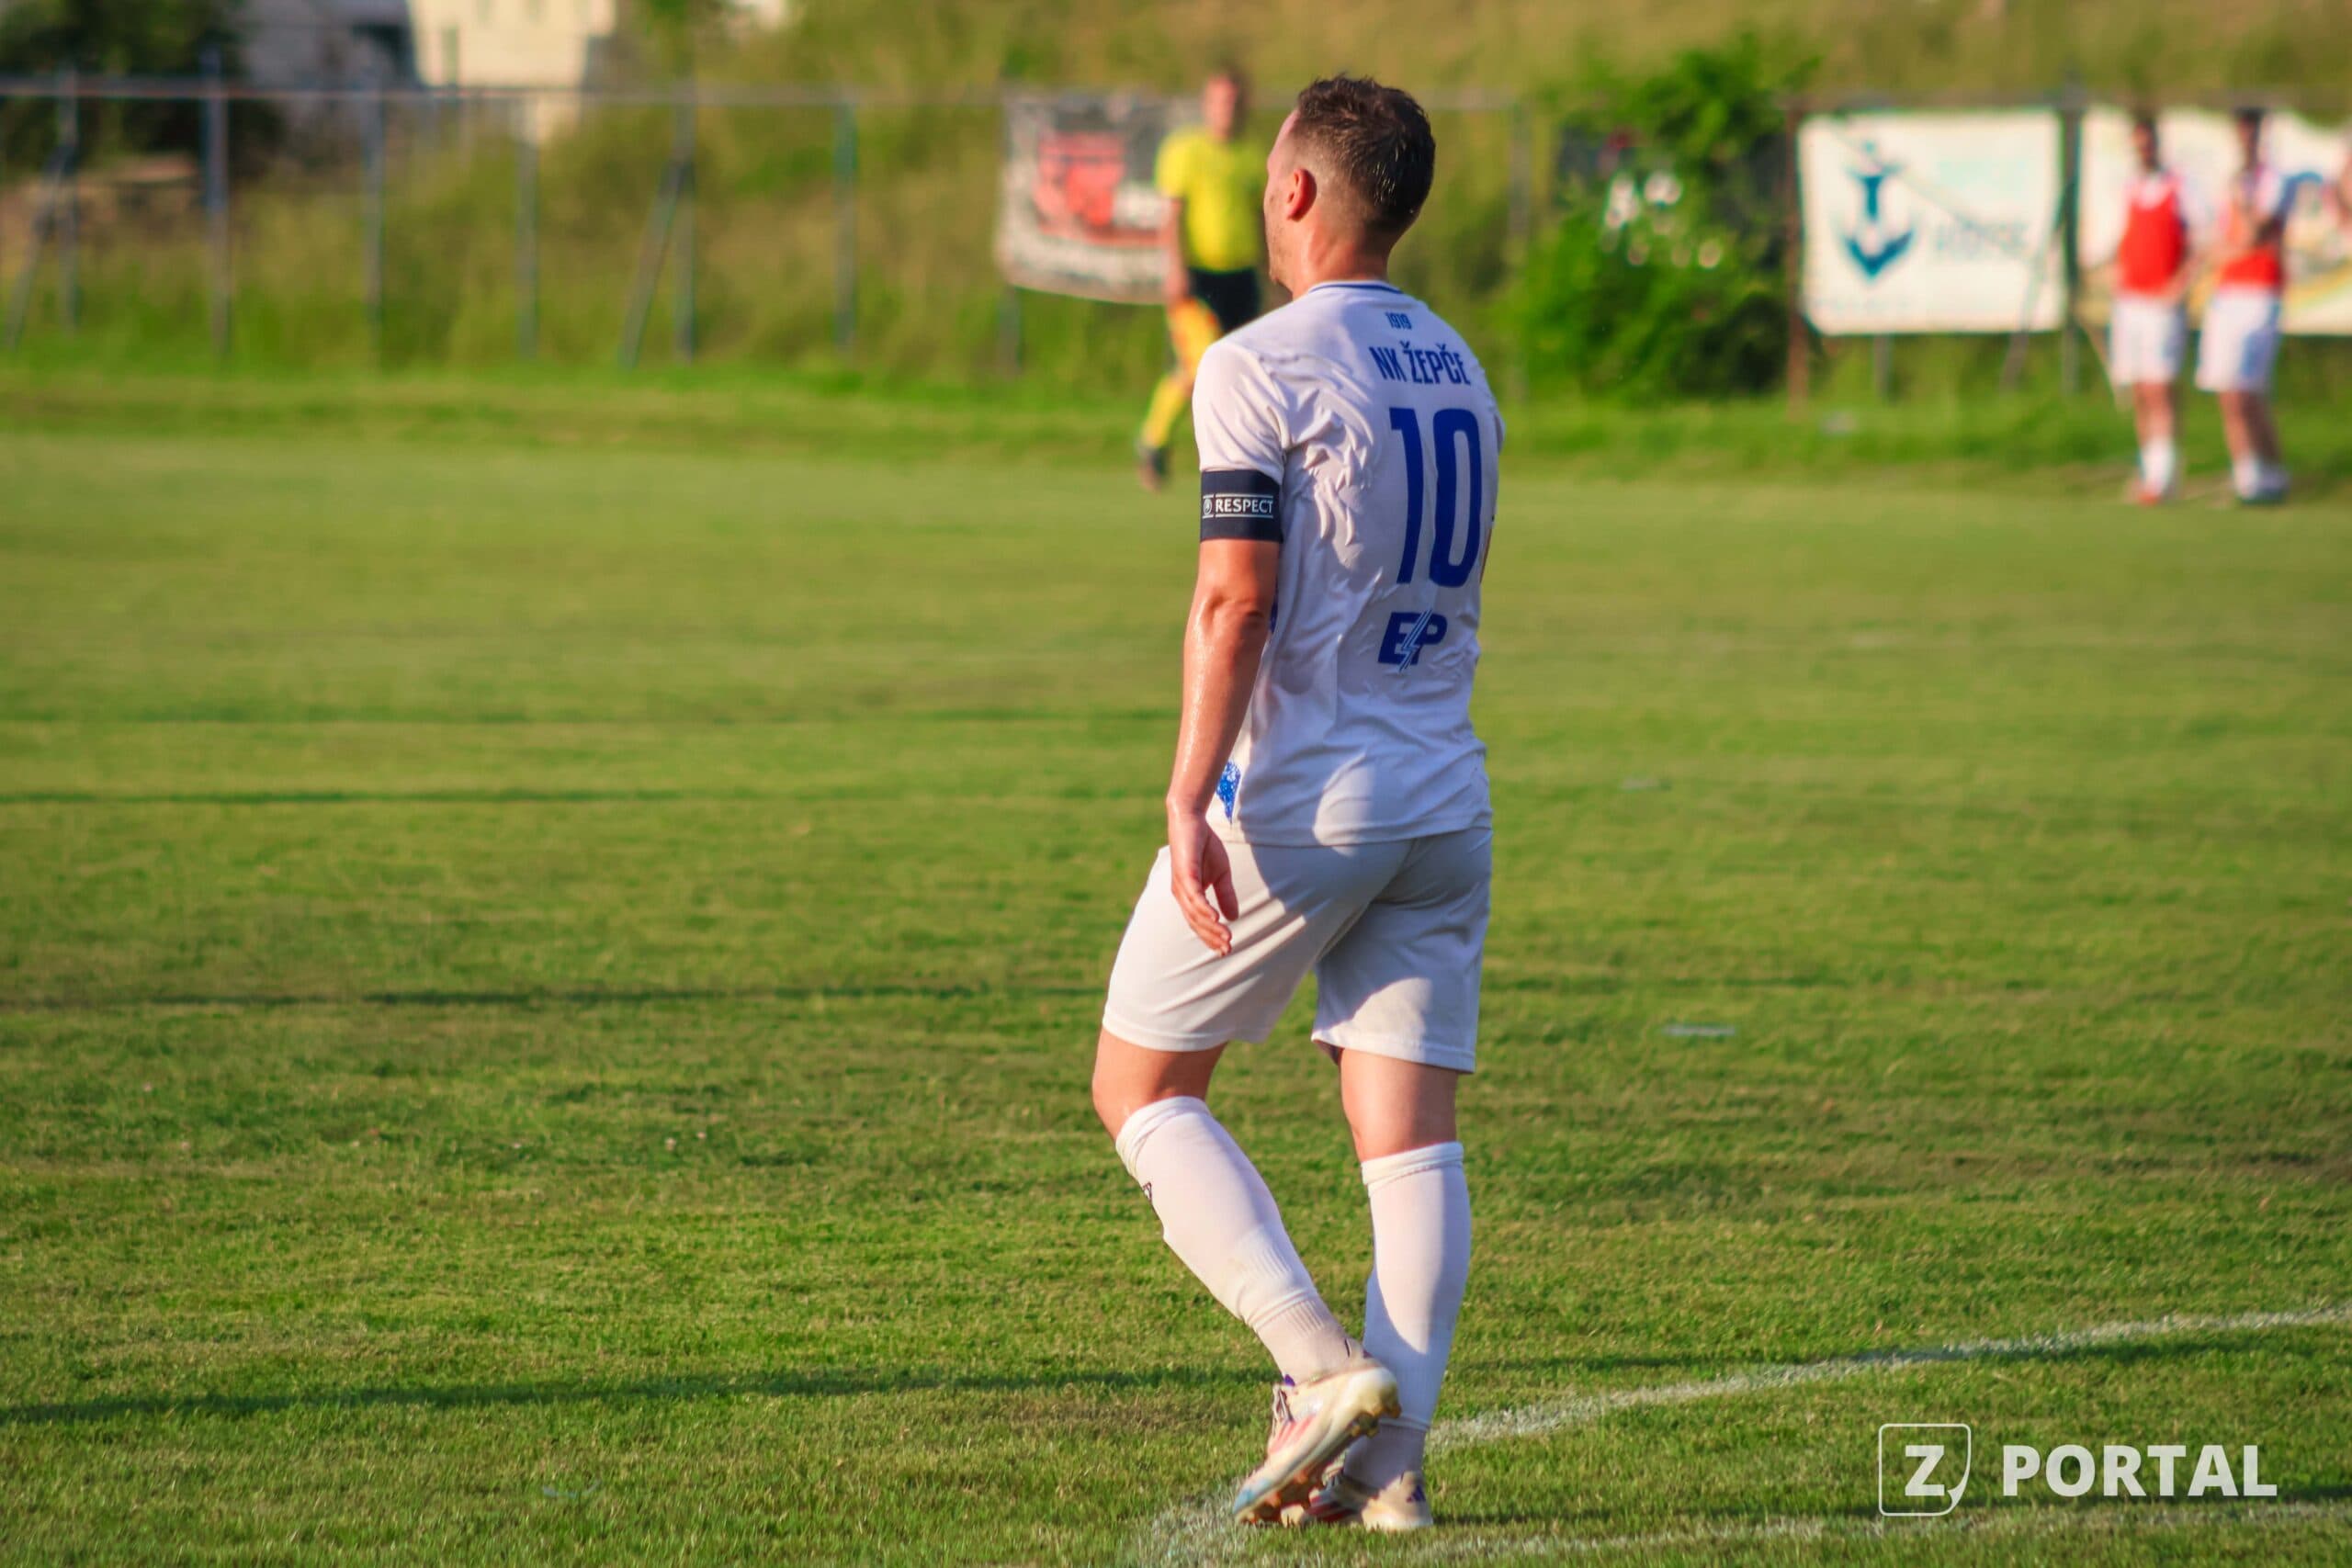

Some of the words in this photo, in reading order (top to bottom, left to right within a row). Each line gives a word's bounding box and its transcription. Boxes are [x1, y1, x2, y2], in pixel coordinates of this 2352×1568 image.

[1368, 346, 1408, 382] NK
[1399, 340, 1471, 385] ŽEPČE
[1215, 498, 1273, 514] RESPECT
[1389, 407, 1482, 588] 10
[1377, 611, 1448, 668] EP
